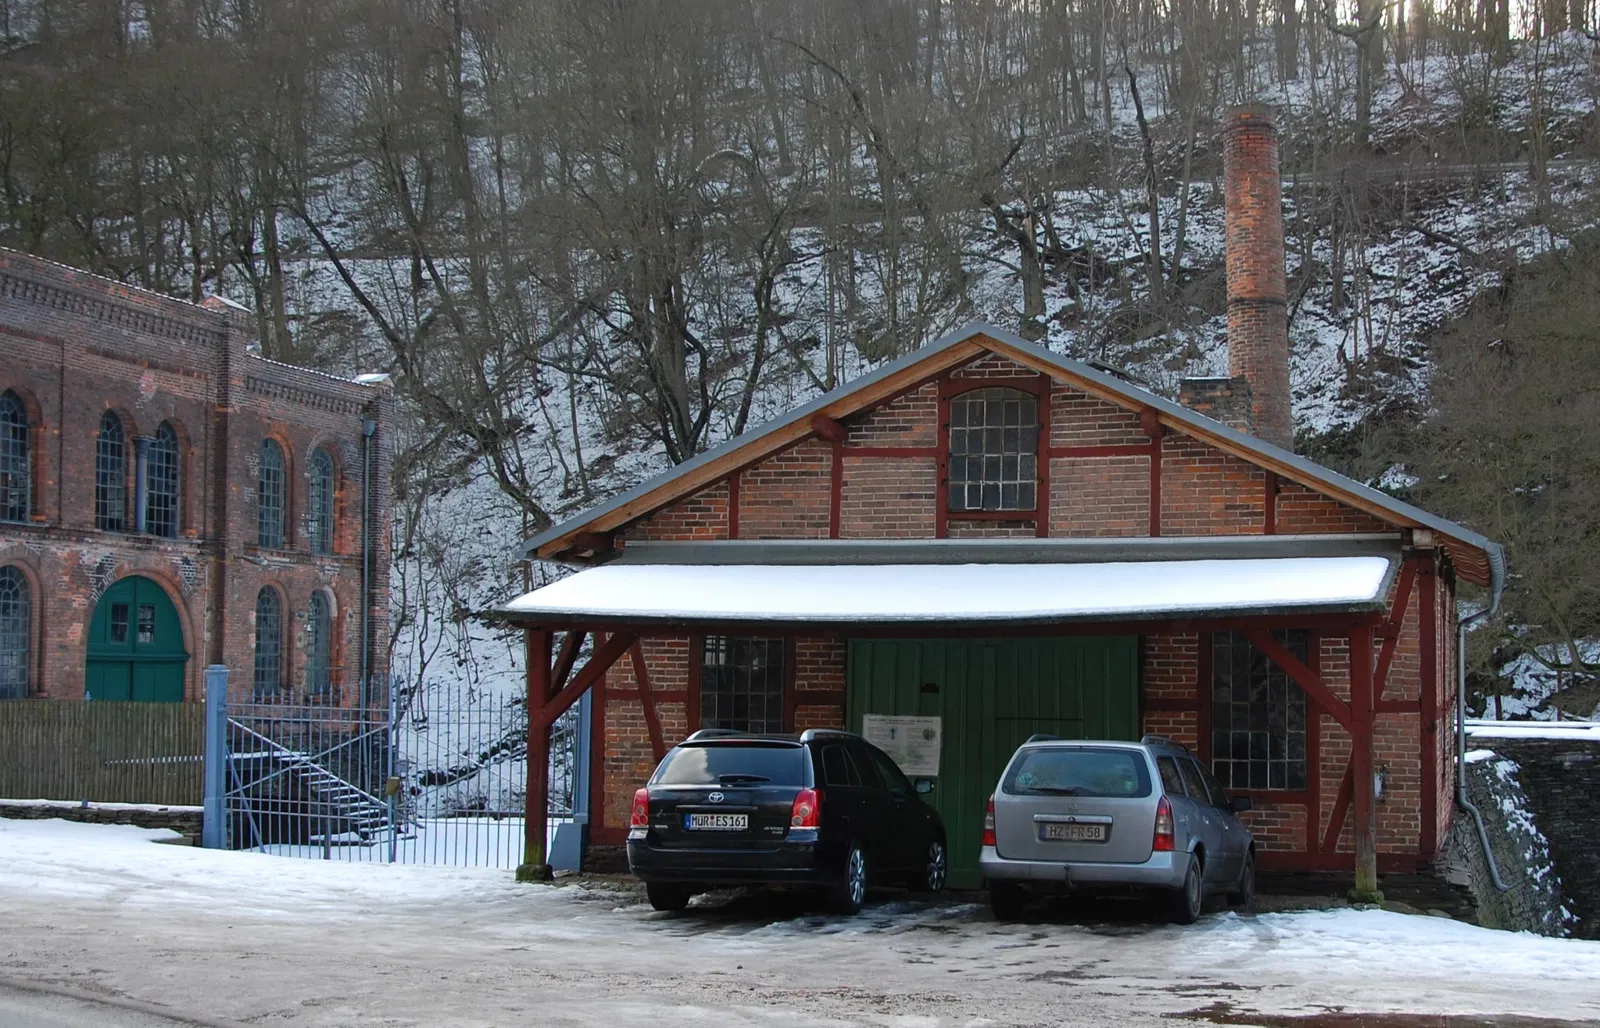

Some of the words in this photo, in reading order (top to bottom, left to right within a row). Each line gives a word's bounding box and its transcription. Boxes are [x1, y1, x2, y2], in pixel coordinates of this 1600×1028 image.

[691, 815, 709, 827] MÜR
[1049, 826, 1064, 837] HZ
[1070, 826, 1085, 838] FR
[1087, 826, 1101, 838] 58
